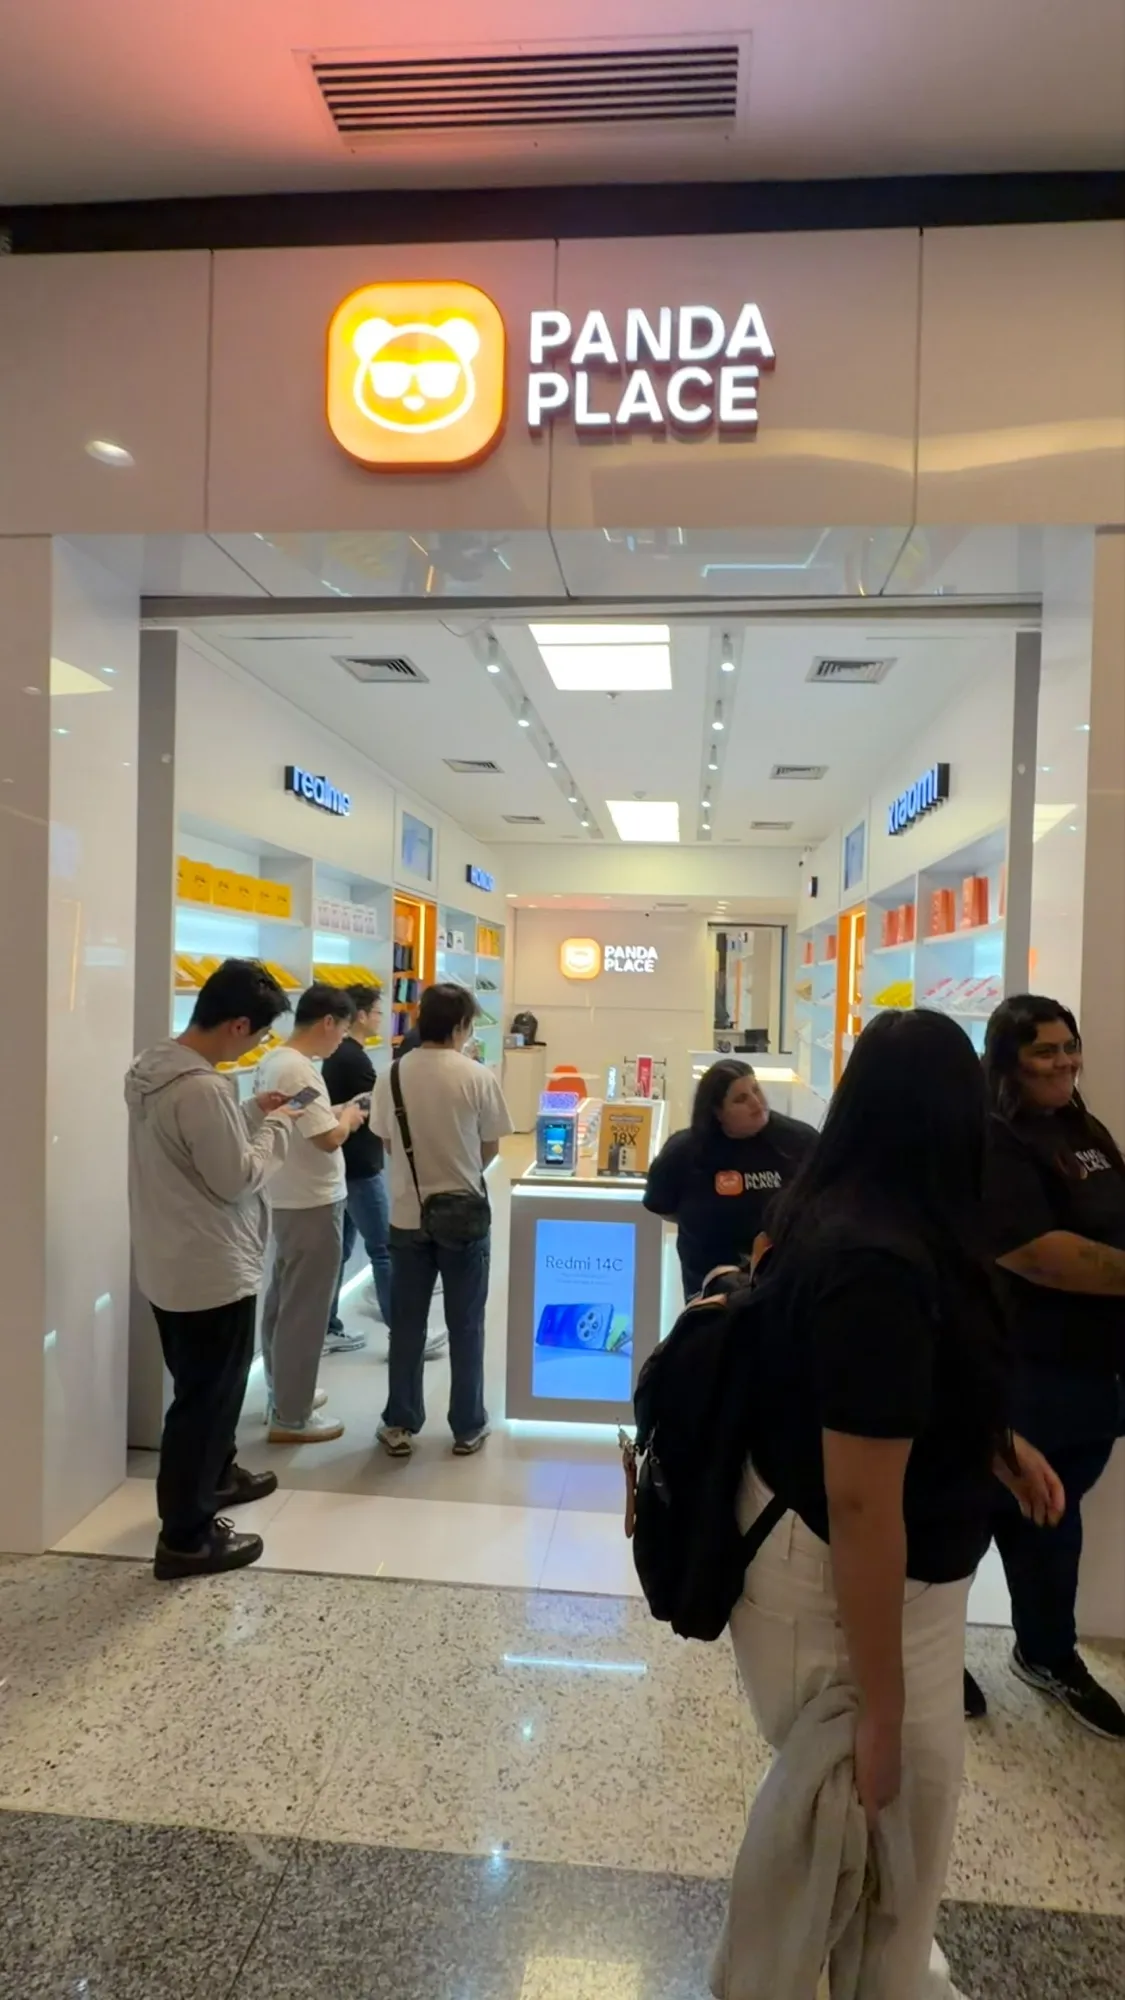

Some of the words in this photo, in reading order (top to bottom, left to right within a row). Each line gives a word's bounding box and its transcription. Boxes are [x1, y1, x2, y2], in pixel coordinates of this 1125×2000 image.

[528, 302, 774, 365] PANDA
[527, 365, 759, 427] PLACE
[291, 765, 351, 817] realme
[887, 762, 938, 834] xiaomi
[603, 945, 658, 960] PANDA
[603, 958, 655, 973] PLACE
[612, 1132, 637, 1146] 18X
[744, 1170, 782, 1181] PANDA
[745, 1179, 782, 1190] PLACE
[545, 1255, 591, 1270] Redmi
[596, 1257, 624, 1271] 14C
